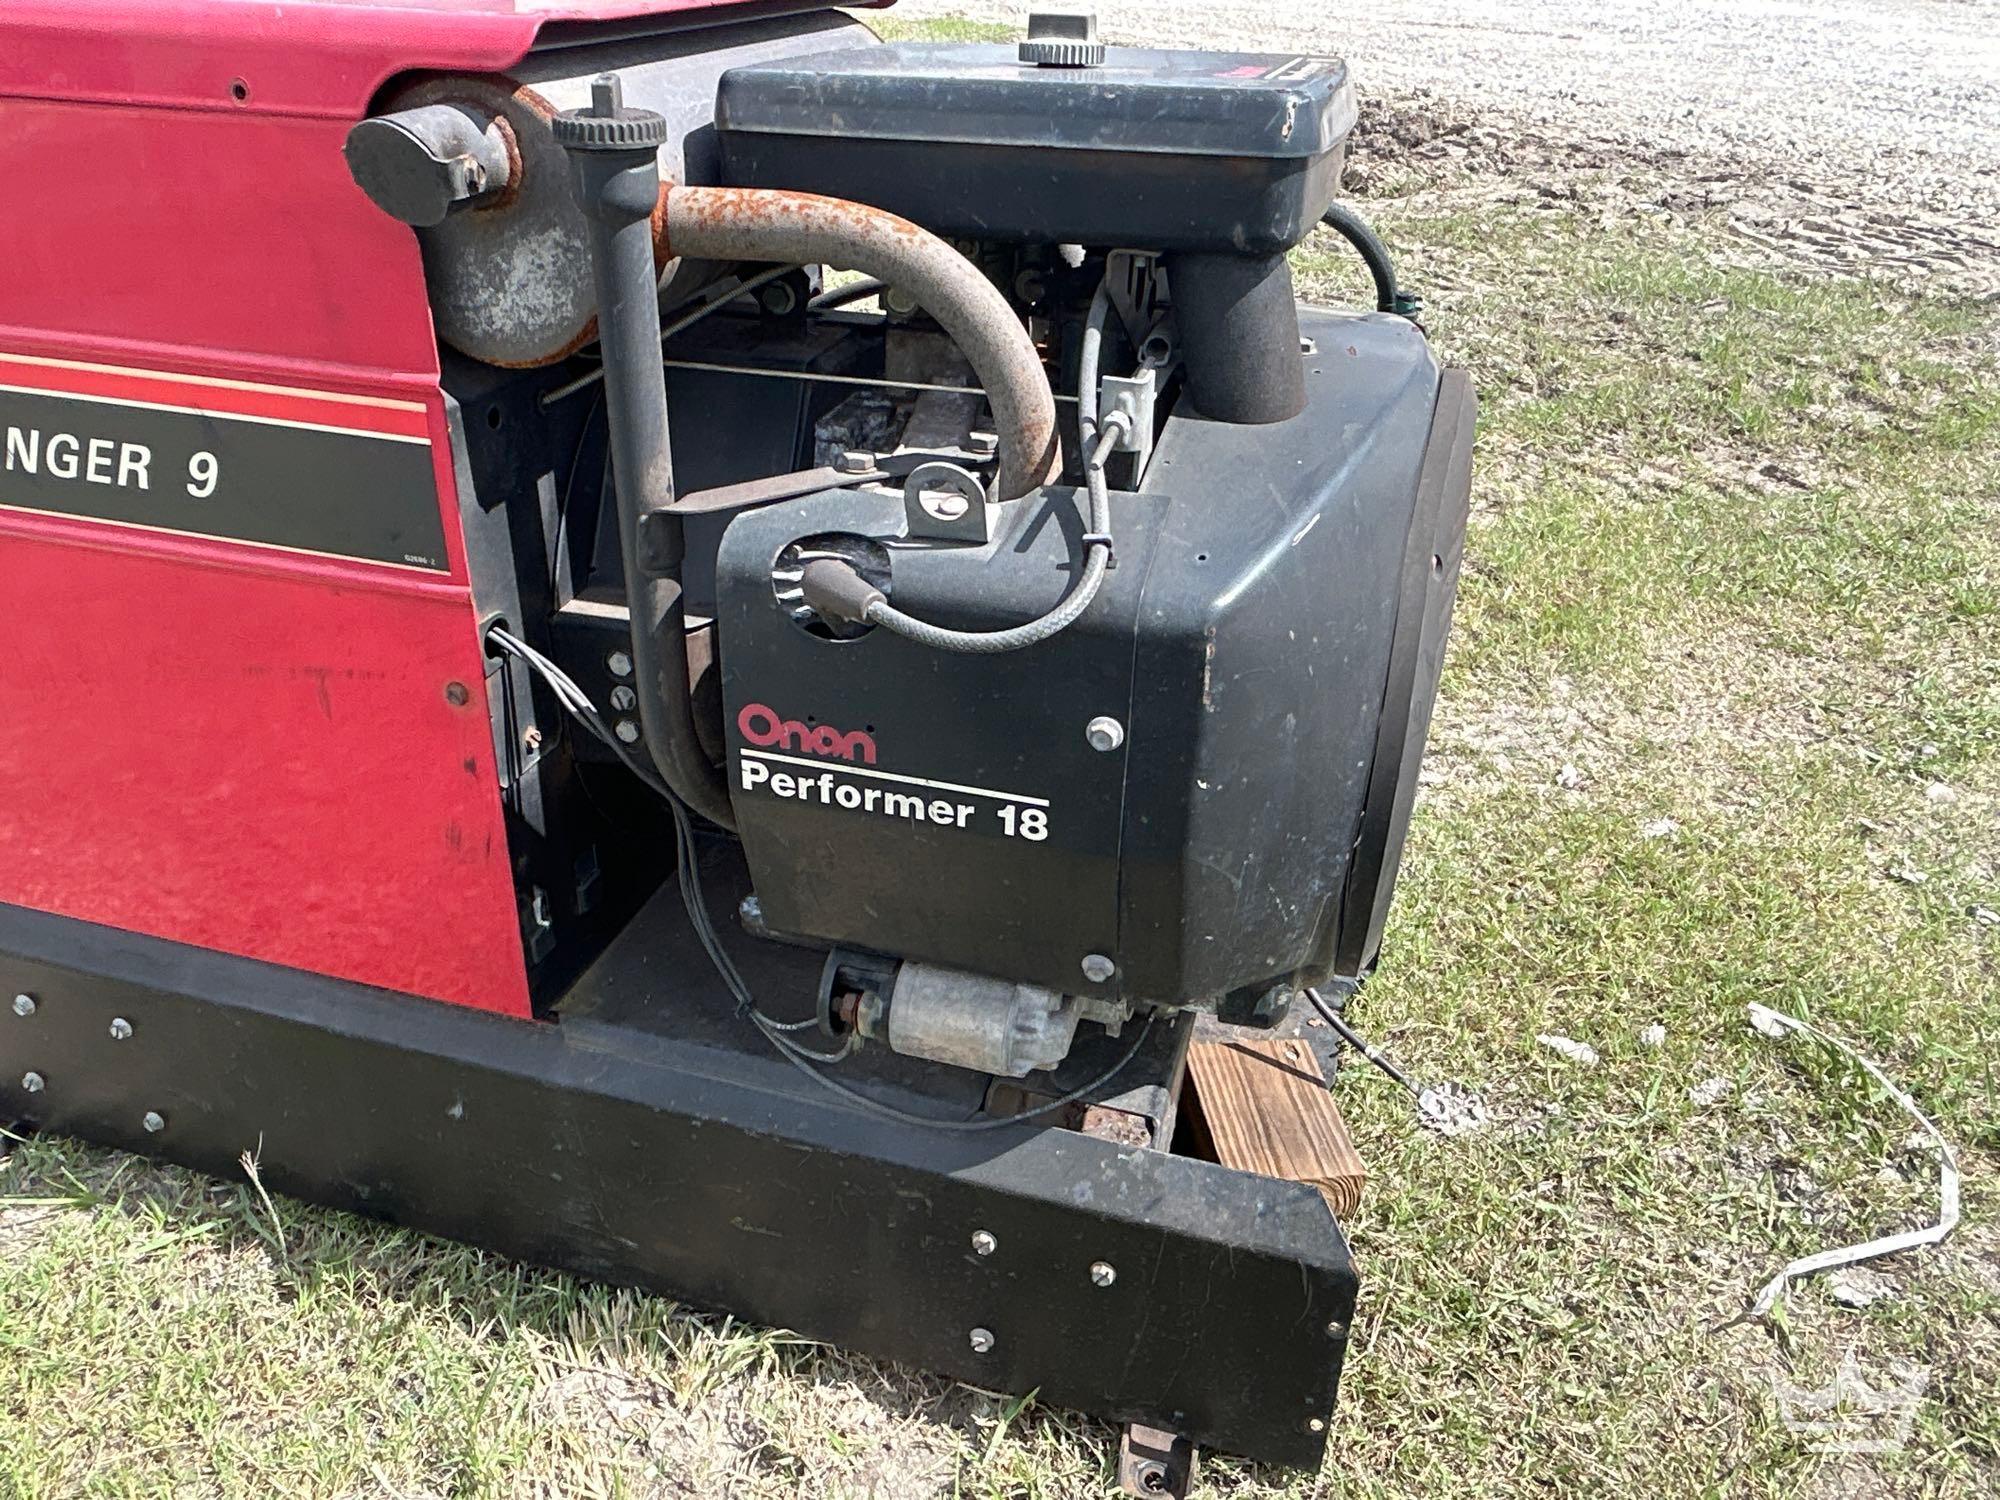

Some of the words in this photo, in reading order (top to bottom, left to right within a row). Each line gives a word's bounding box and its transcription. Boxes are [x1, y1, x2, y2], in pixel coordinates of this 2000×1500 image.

[6, 427, 151, 490] NGER
[187, 452, 219, 498] 9
[737, 704, 876, 763] Onan
[741, 760, 974, 828] Performer
[998, 805, 1048, 840] 18
